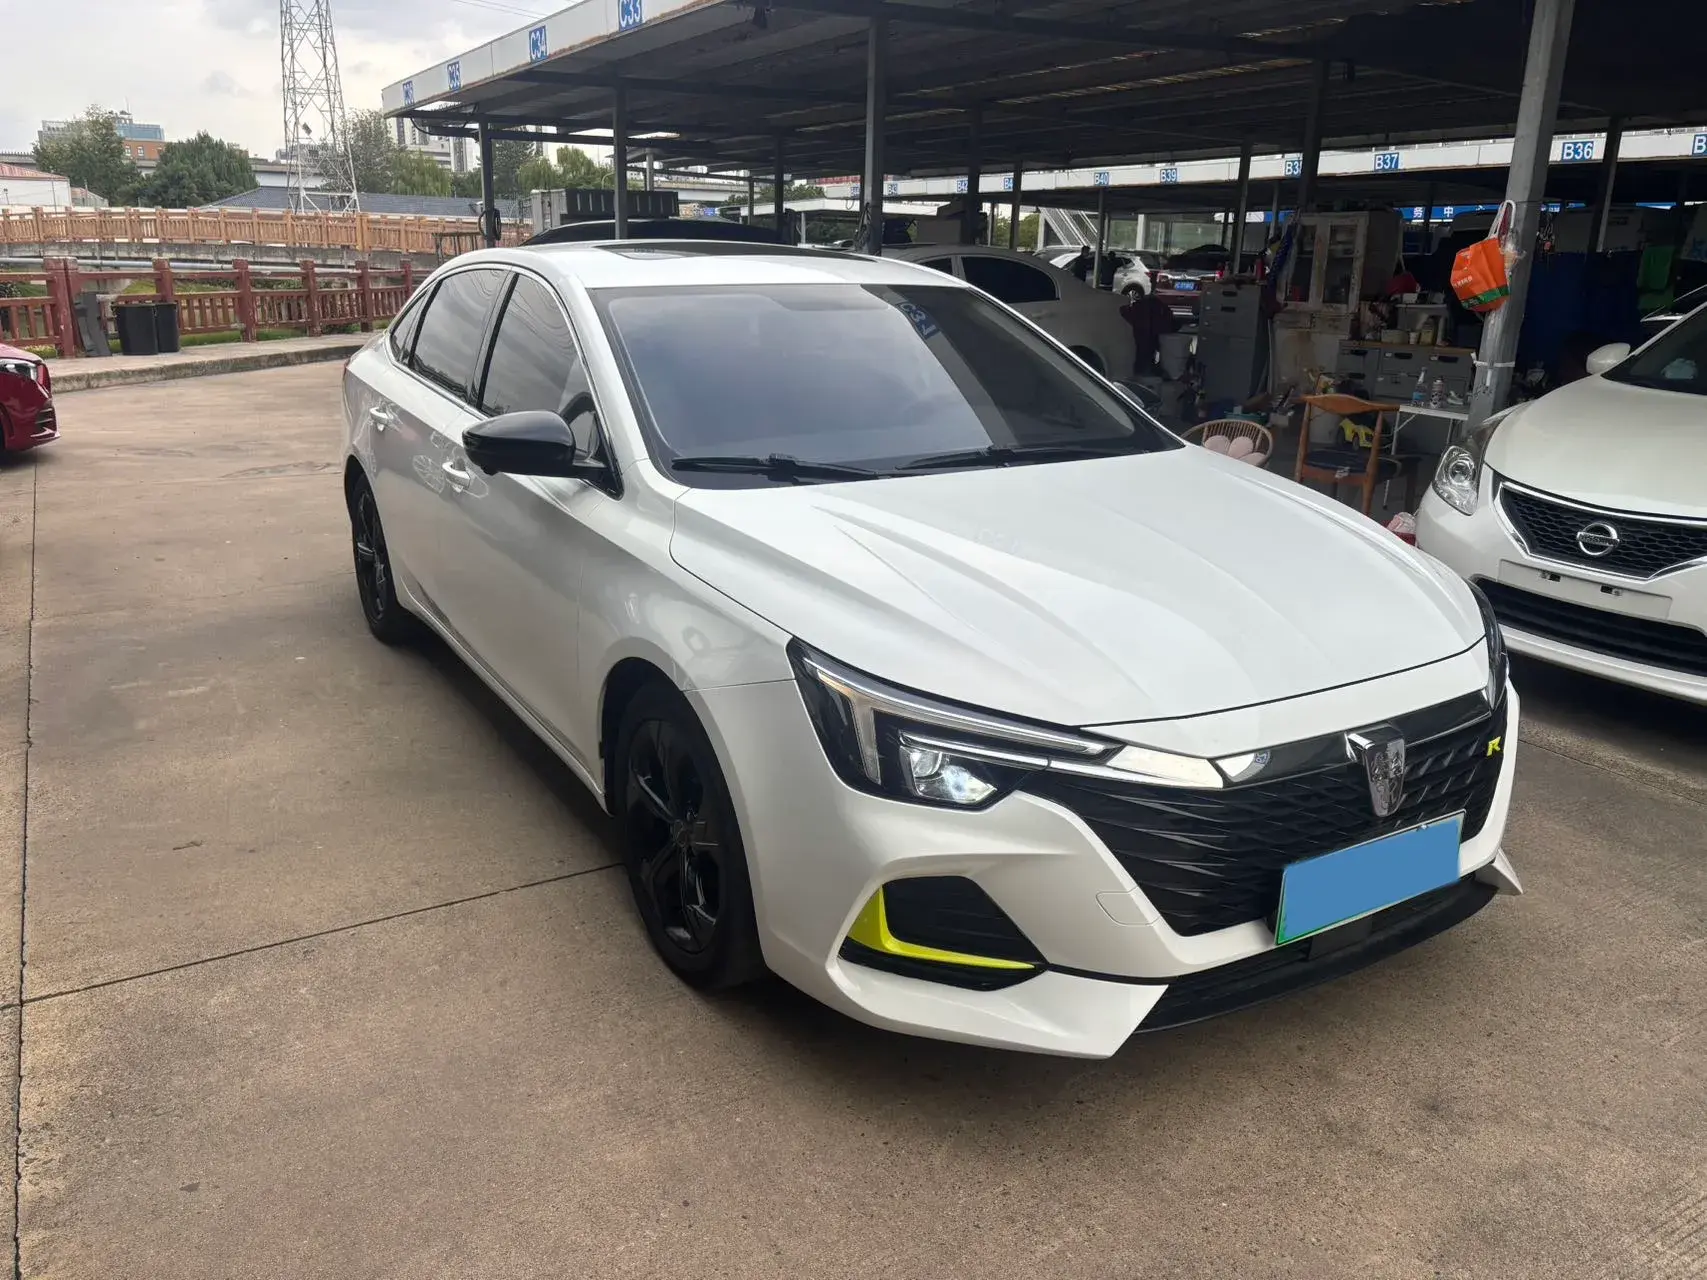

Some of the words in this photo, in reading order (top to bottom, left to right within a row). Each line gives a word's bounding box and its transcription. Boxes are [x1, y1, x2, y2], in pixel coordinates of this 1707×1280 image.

[620, 0, 641, 27] C33
[530, 28, 547, 60] C34
[1563, 142, 1593, 160] B36
[1694, 136, 1707, 154] B
[1375, 154, 1399, 170] B37
[1004, 178, 1014, 190] B4
[1095, 172, 1109, 185] B40
[1161, 169, 1177, 182] B39
